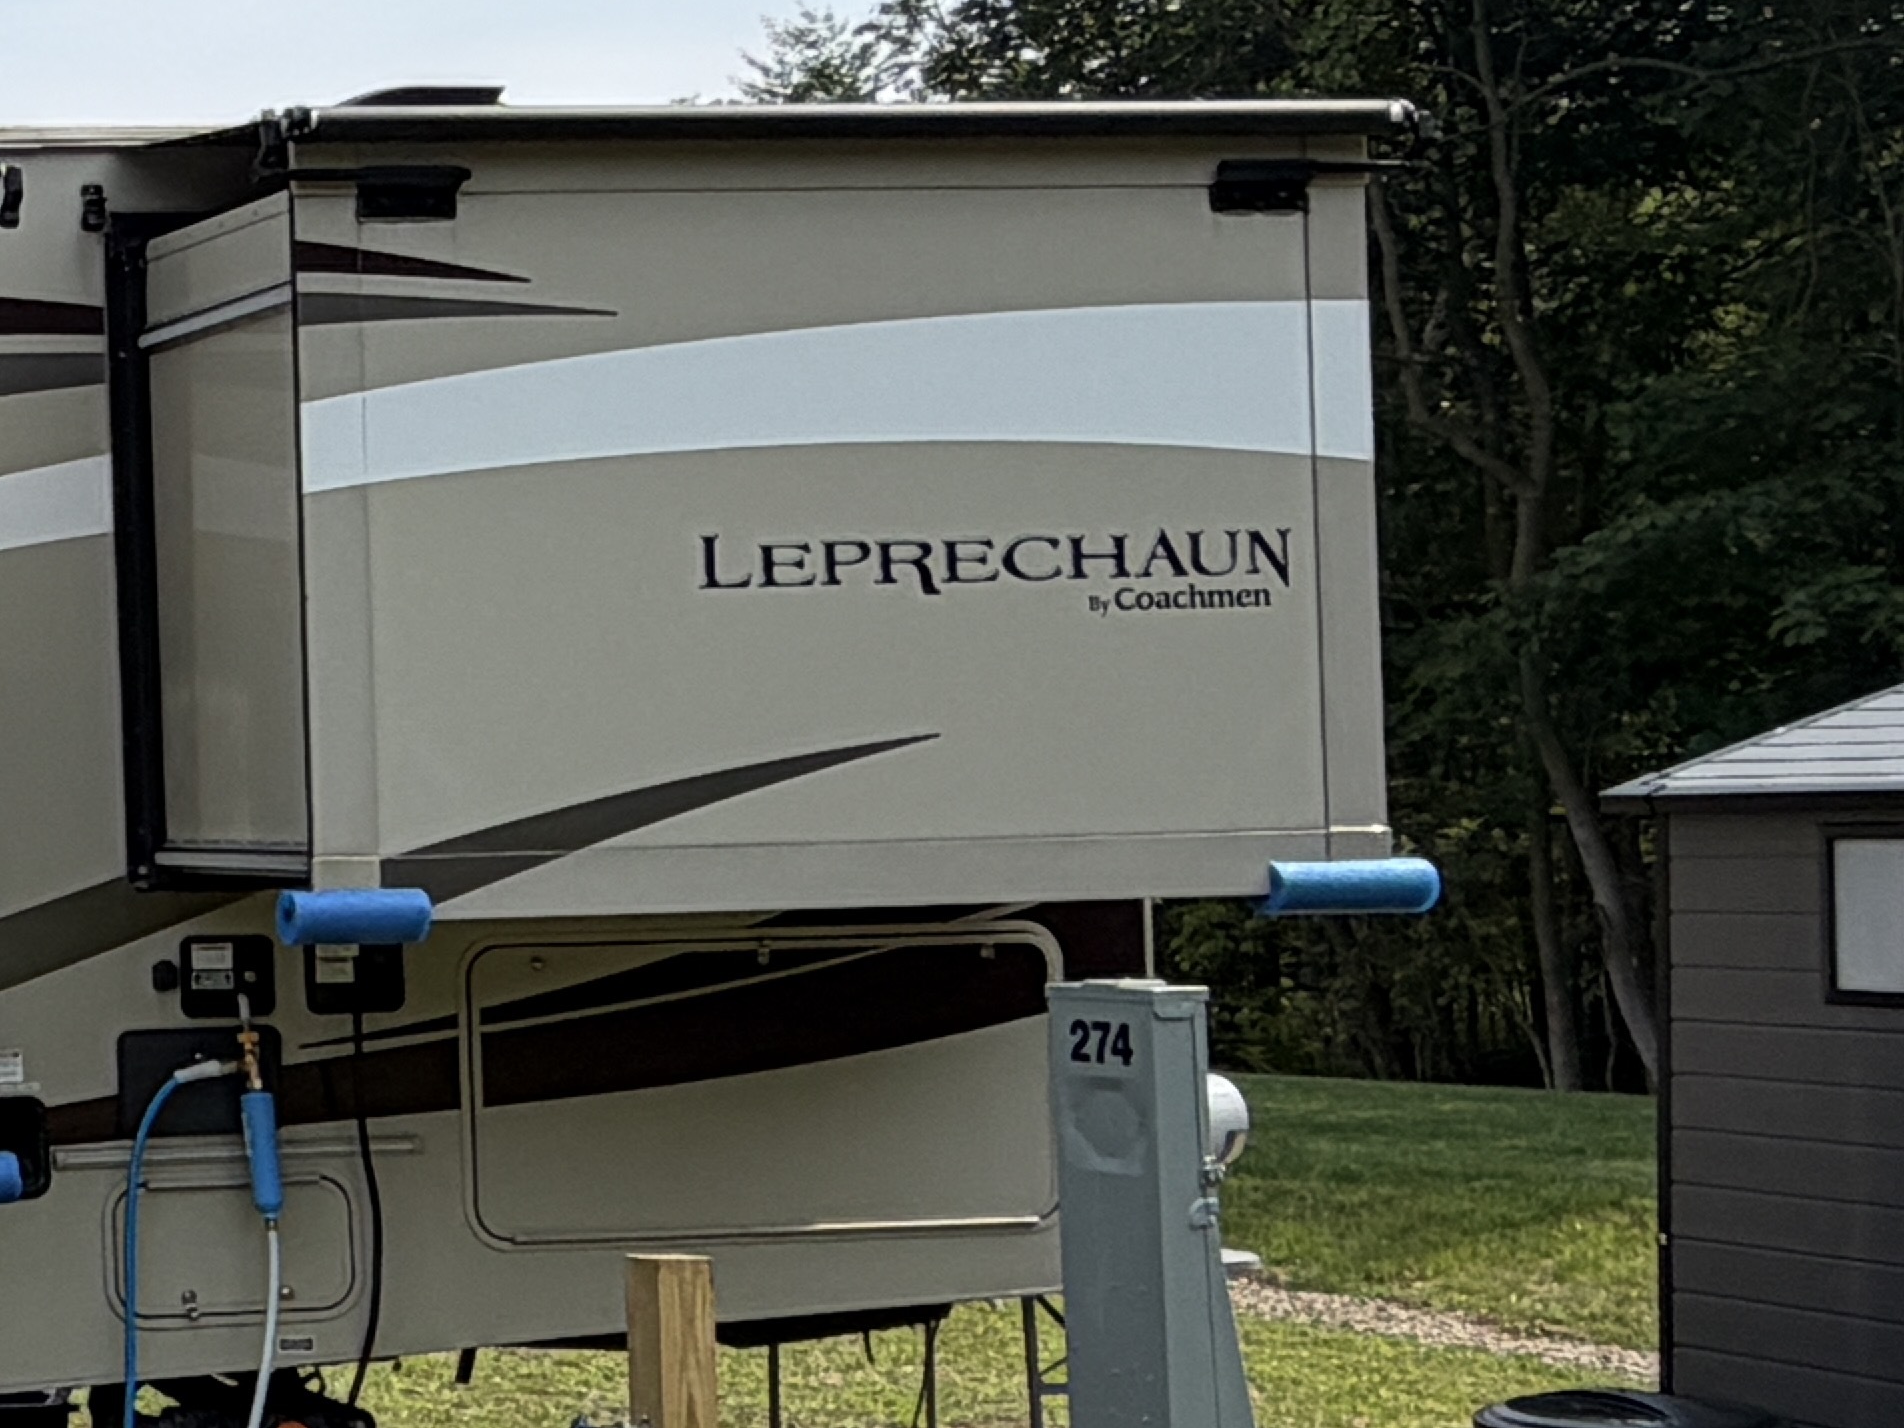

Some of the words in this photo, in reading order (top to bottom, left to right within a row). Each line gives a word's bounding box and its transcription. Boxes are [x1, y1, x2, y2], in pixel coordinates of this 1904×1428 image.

[698, 527, 1292, 595] LEPRECHAUN
[1088, 595, 1111, 616] By
[1113, 583, 1272, 612] Coachmen
[1069, 1018, 1134, 1066] 274
